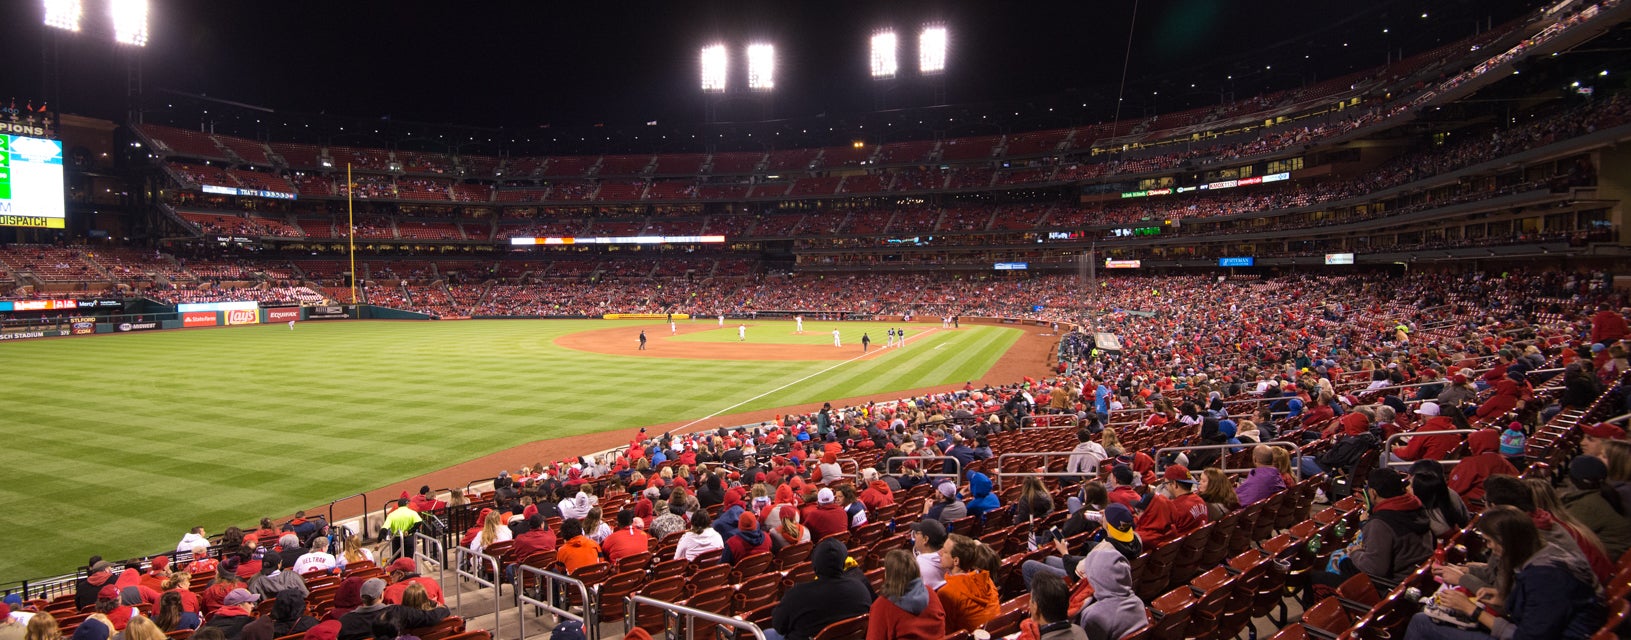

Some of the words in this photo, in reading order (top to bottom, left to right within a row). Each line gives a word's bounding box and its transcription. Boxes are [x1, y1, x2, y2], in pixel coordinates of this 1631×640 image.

[0, 123, 44, 136] PIONS
[0, 215, 48, 227] DISPATCH
[270, 311, 298, 319] EQUIFAX
[14, 331, 44, 339] STADIUM
